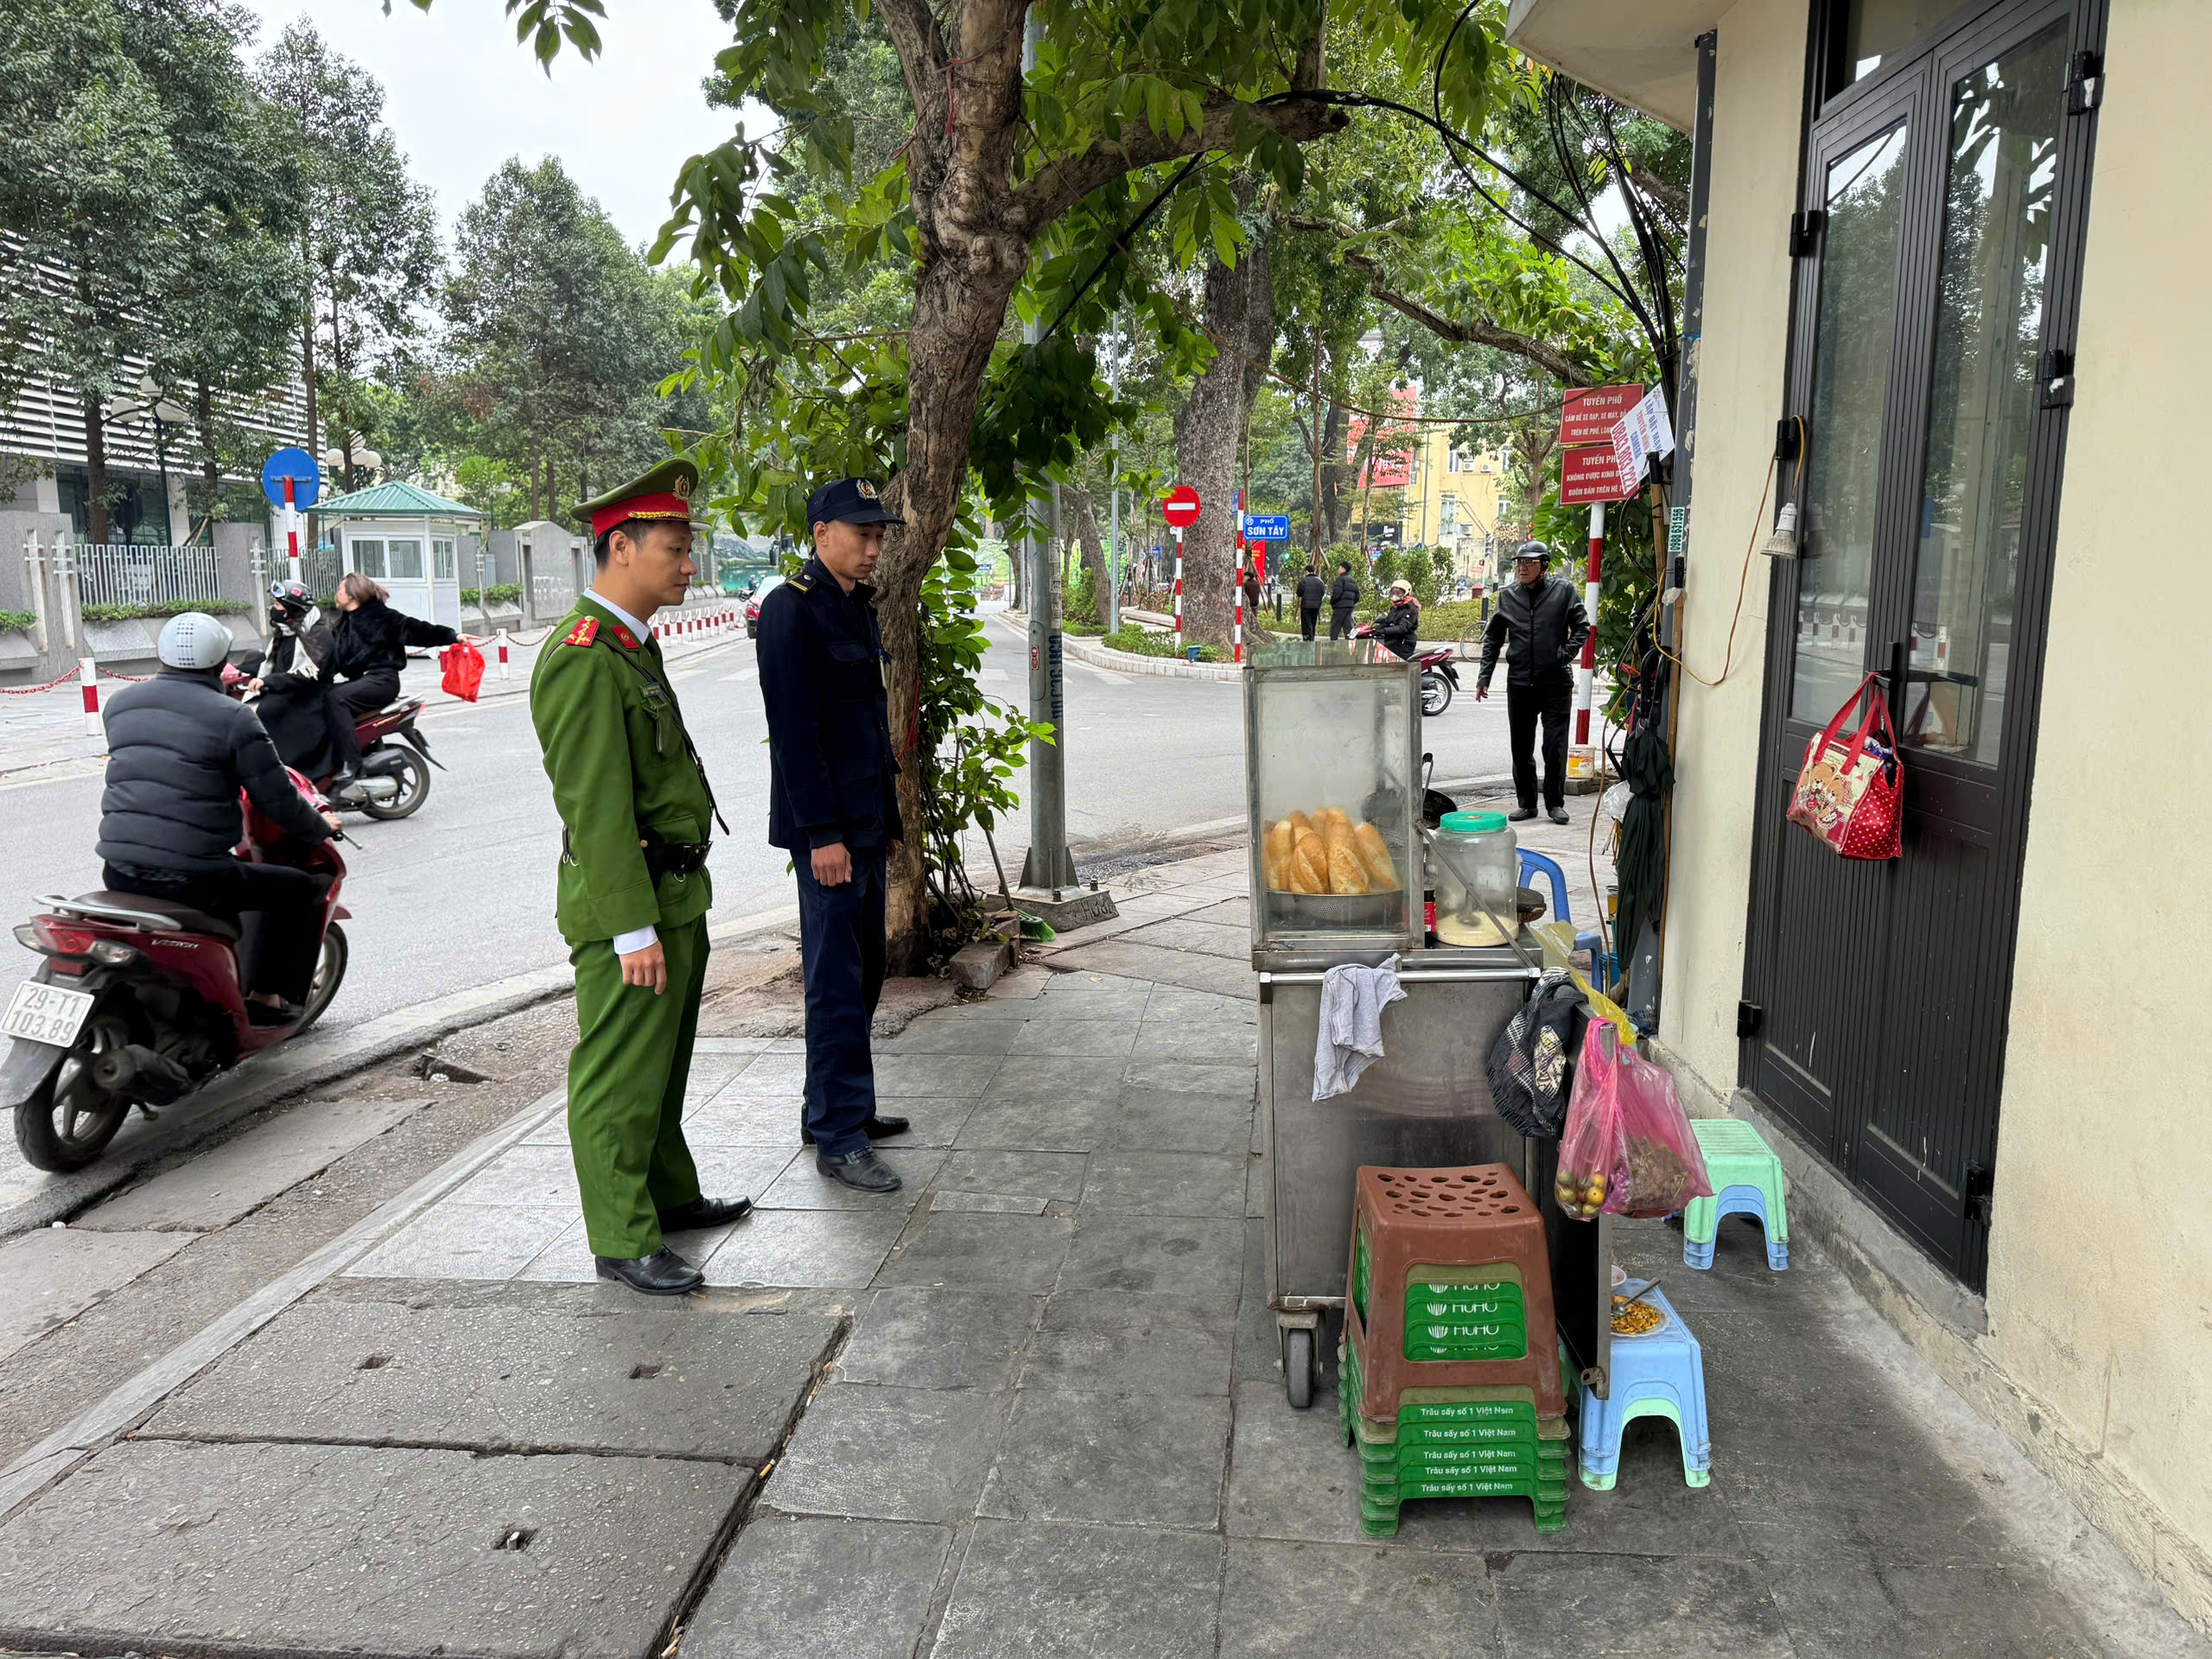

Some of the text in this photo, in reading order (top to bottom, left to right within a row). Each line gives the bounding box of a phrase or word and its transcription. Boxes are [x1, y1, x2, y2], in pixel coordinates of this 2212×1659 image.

[1607, 392, 1623, 404] PHỐ
[1630, 431, 1642, 460] CAMERA
[1606, 454, 1618, 465] PH
[1612, 421, 1637, 493] 0843.803.222
[1567, 472, 1585, 482] KHÔNG
[1601, 470, 1614, 479] KINH
[1247, 524, 1285, 536] SƠN TÂY
[23, 988, 81, 1017] 29-T1
[1421, 1408, 1439, 1416] Trâu
[1441, 1408, 1455, 1417] sấy
[1457, 1407, 1467, 1415] số
[1476, 1407, 1492, 1415] Việt
[1424, 1429, 1442, 1438] Trâu
[1444, 1428, 1458, 1439] sấy
[1459, 1428, 1470, 1437] số
[1478, 1428, 1495, 1438] Việt
[1444, 1450, 1458, 1460] sấy
[1459, 1450, 1470, 1459] số
[1478, 1450, 1495, 1459] Việt
[1425, 1466, 1443, 1475] Trâu
[1445, 1465, 1459, 1476] sấy
[1461, 1465, 1471, 1474] số
[1479, 1465, 1497, 1474] Việt
[1421, 1484, 1440, 1492] Trâu
[1441, 1483, 1455, 1493] sấy
[1476, 1483, 1492, 1491] Việt
